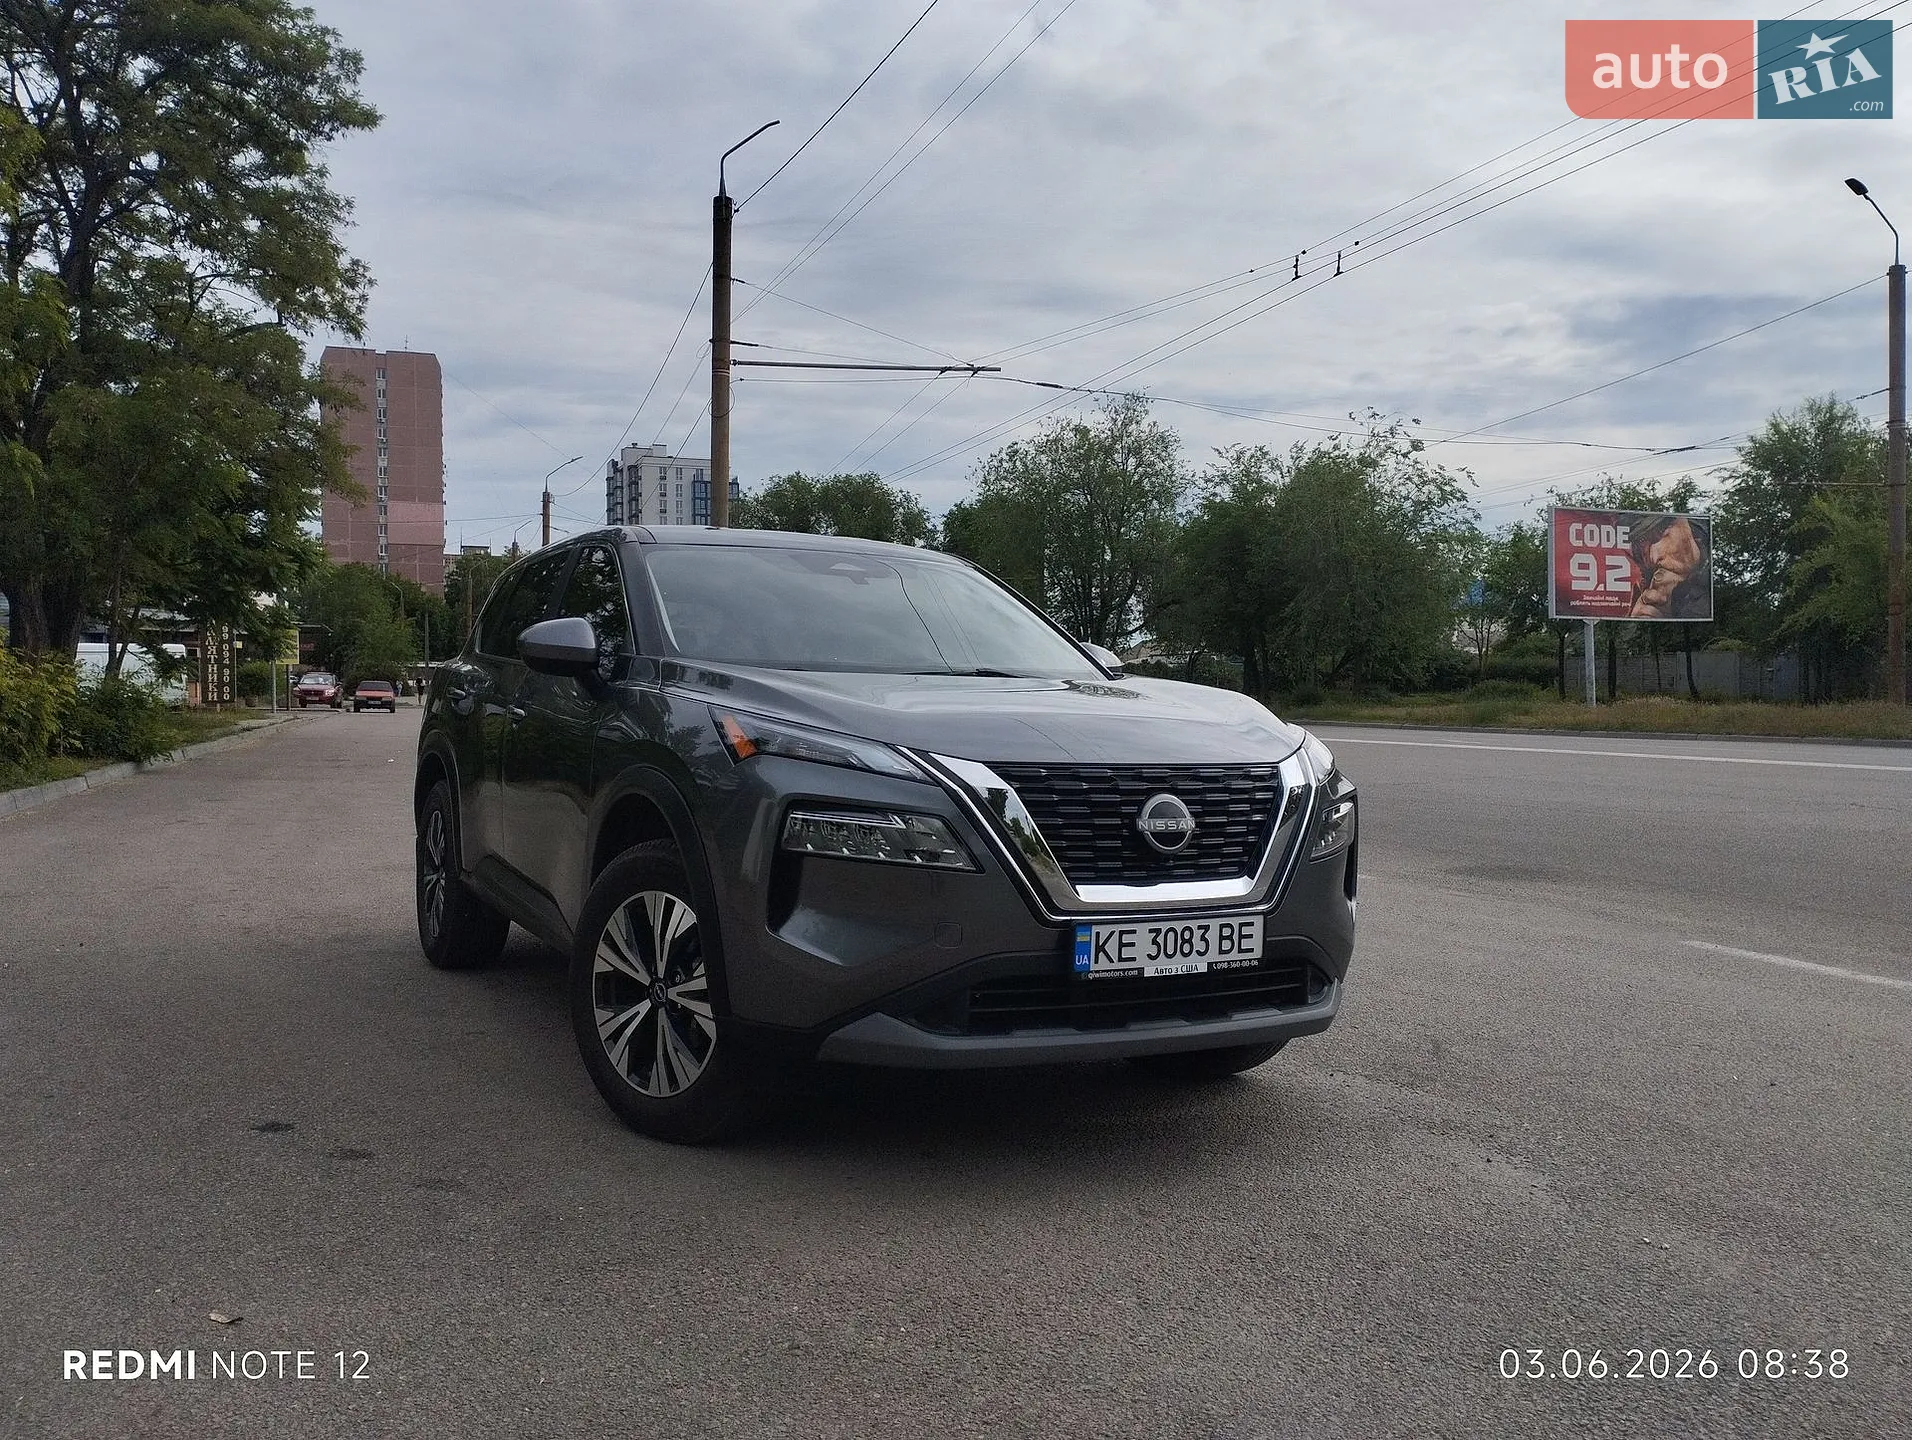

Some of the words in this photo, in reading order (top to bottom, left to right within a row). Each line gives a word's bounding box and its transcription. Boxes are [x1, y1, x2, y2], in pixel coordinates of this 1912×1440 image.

[1569, 522, 1632, 550] CODE
[1569, 553, 1631, 592] 9.2
[1138, 819, 1196, 830] NISSAN
[1093, 929, 1137, 964] KE
[1146, 924, 1211, 962] 3083
[1218, 921, 1255, 955] BE
[1075, 955, 1090, 966] UA
[1153, 966, 1173, 976] Авто
[1180, 964, 1199, 974] США
